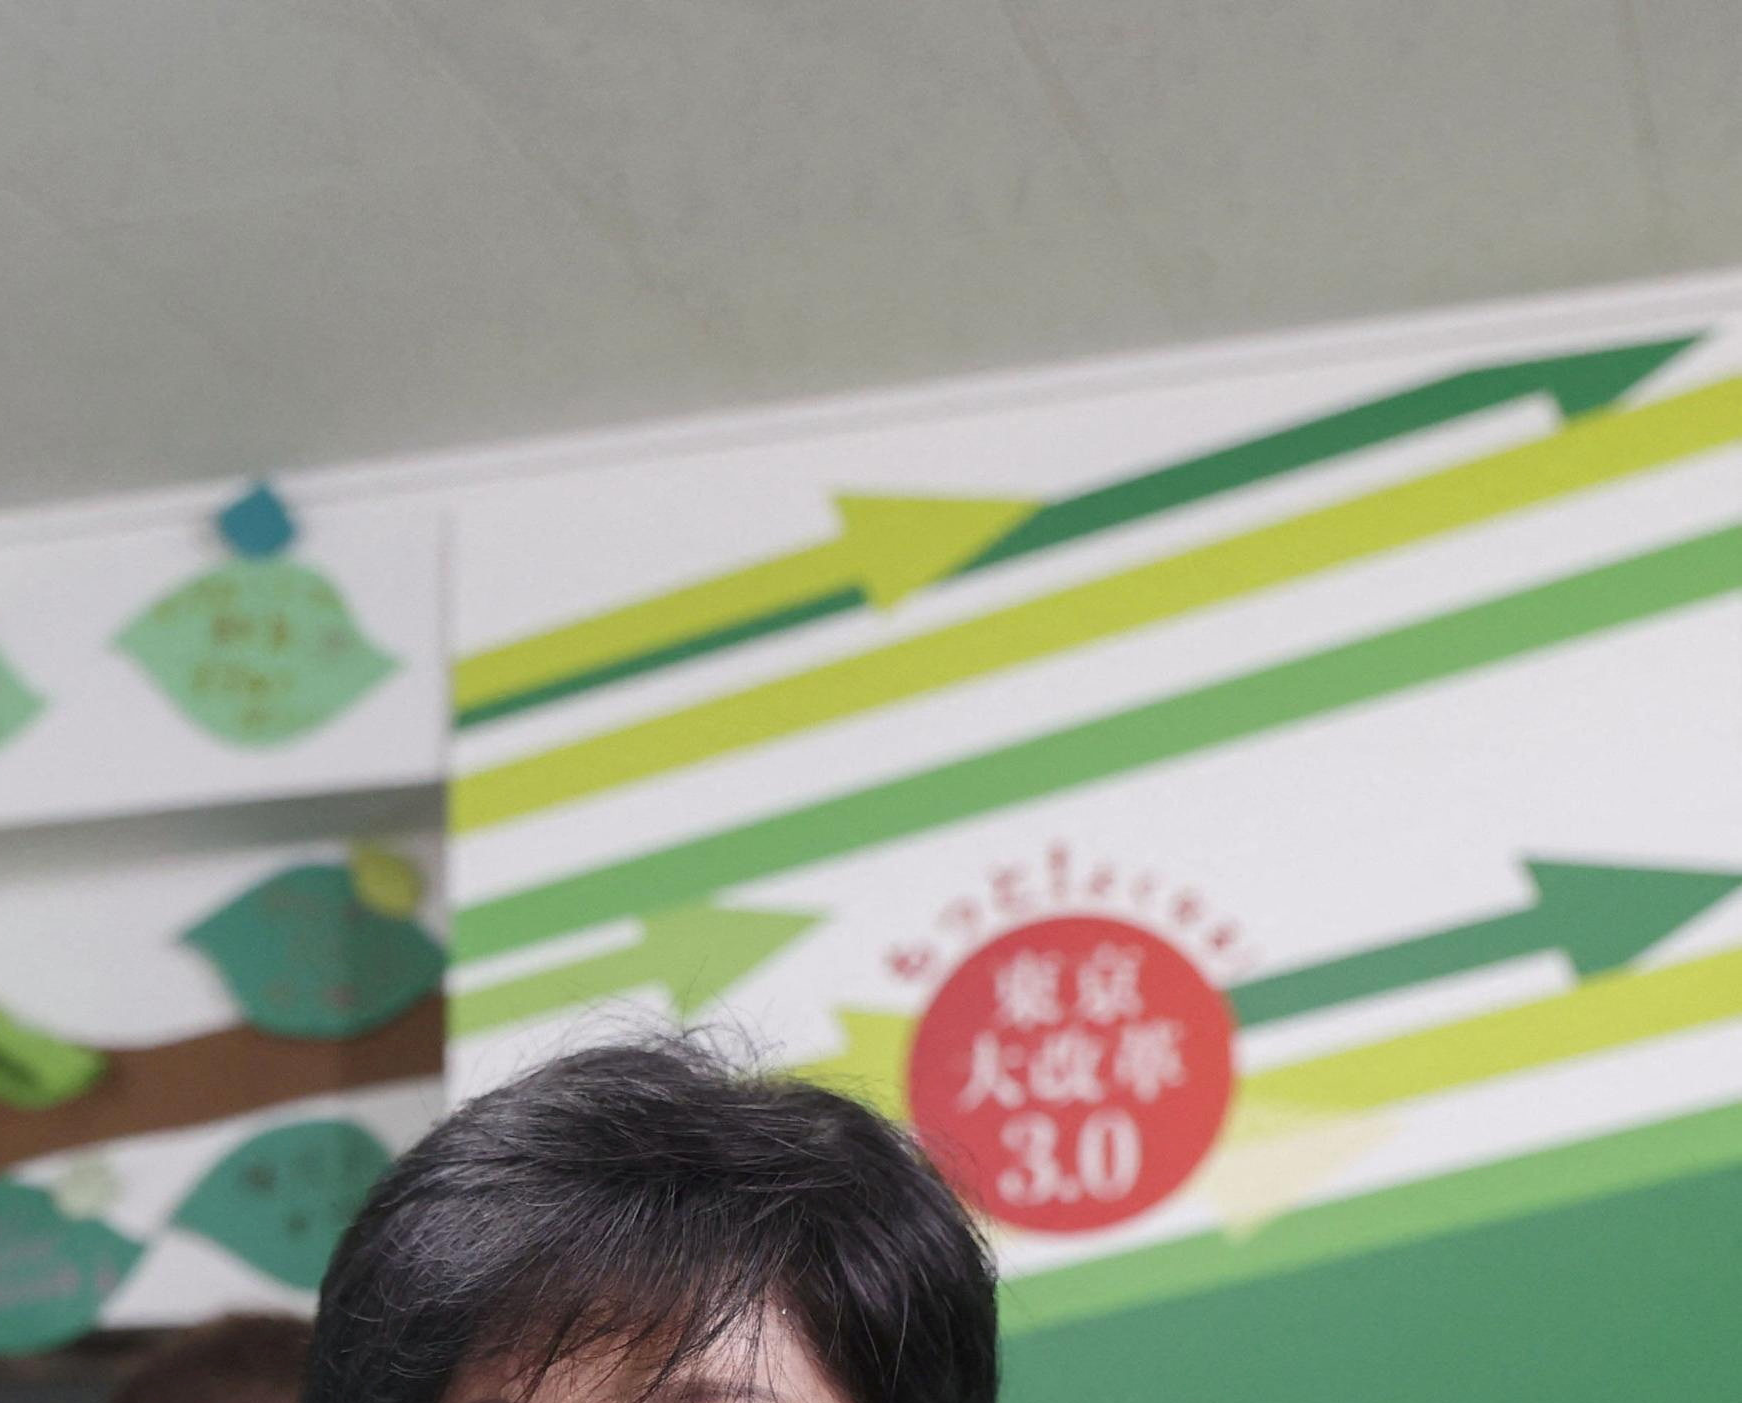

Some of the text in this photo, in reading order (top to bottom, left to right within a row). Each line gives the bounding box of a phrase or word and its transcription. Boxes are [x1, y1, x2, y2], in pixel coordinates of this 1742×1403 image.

[992, 942, 1144, 1030] 東京
[955, 1017, 1188, 1112] 大改革
[996, 1107, 1143, 1206] 3.0
